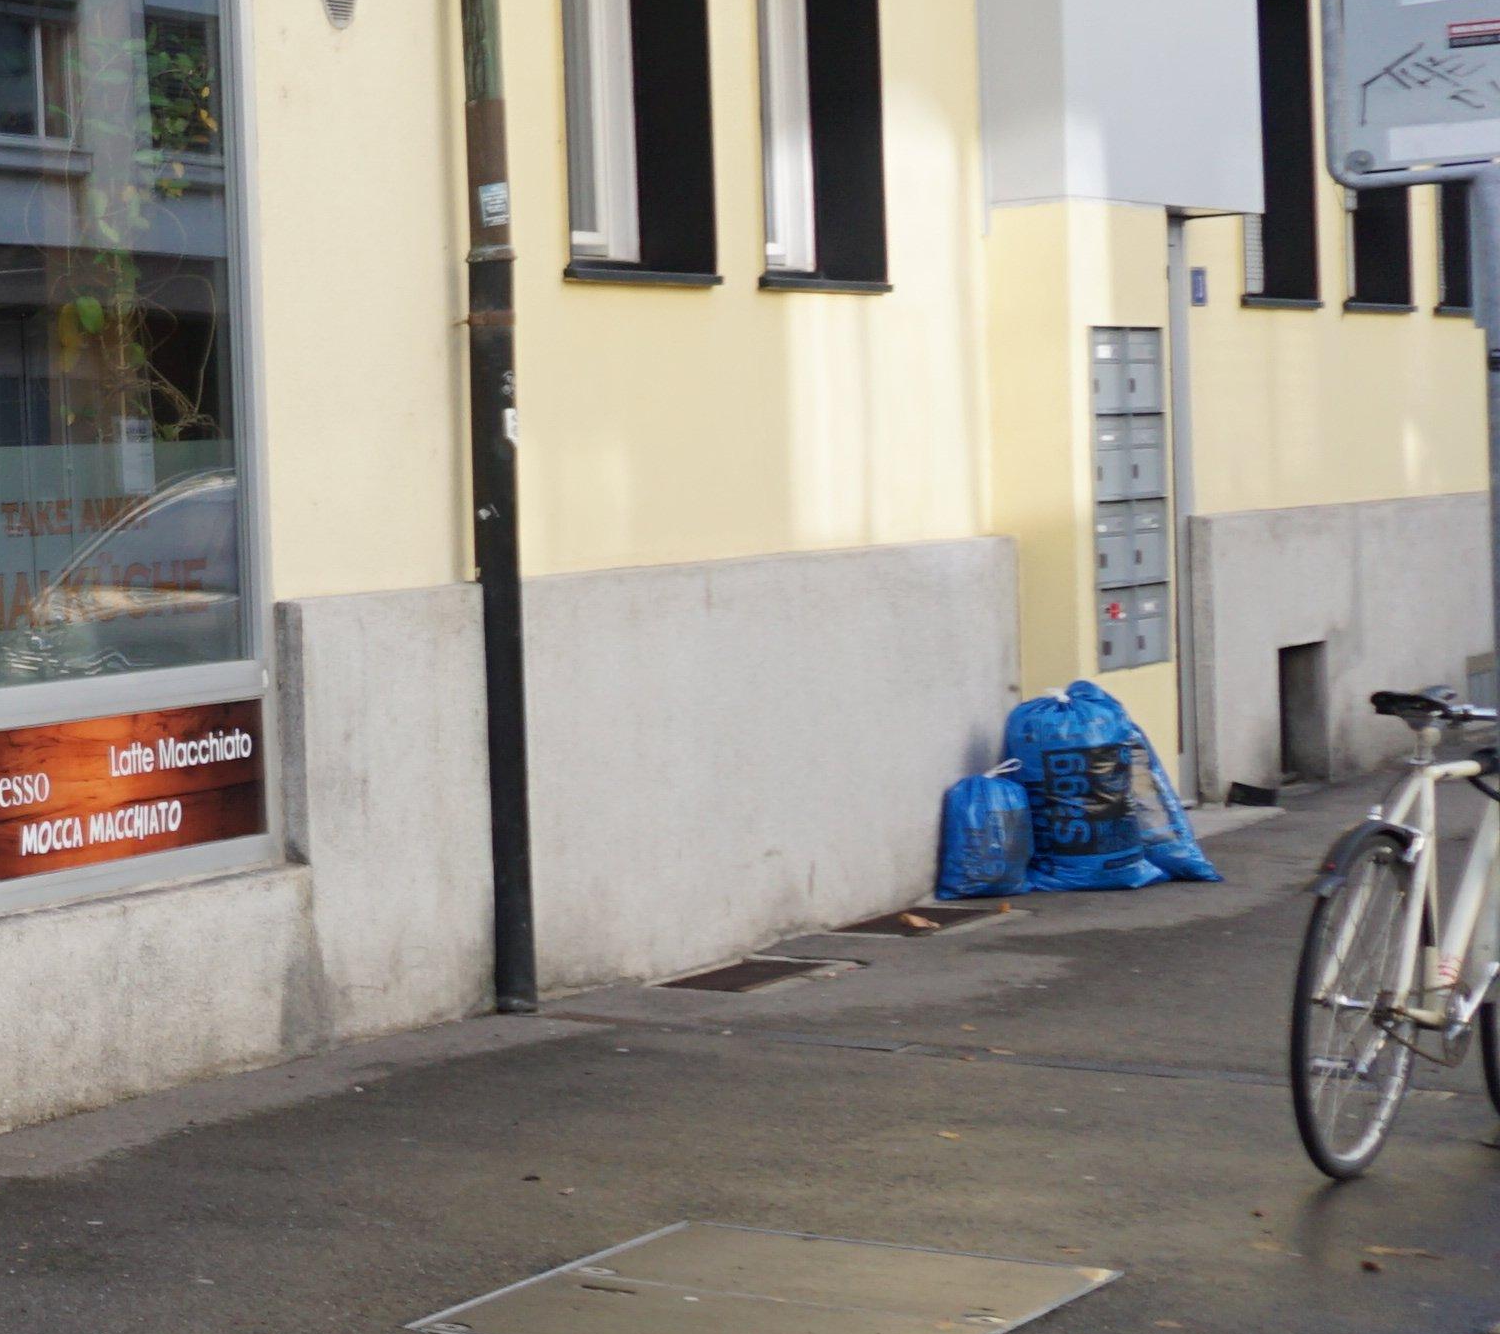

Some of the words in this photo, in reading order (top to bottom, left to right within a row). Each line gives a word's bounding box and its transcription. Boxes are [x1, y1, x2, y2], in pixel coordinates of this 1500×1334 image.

[0, 498, 72, 538] TAKE
[109, 741, 155, 777] Latte
[158, 728, 252, 770] Macchiato
[20, 816, 84, 857] MOCCA
[88, 799, 183, 845] MACCHIATO
